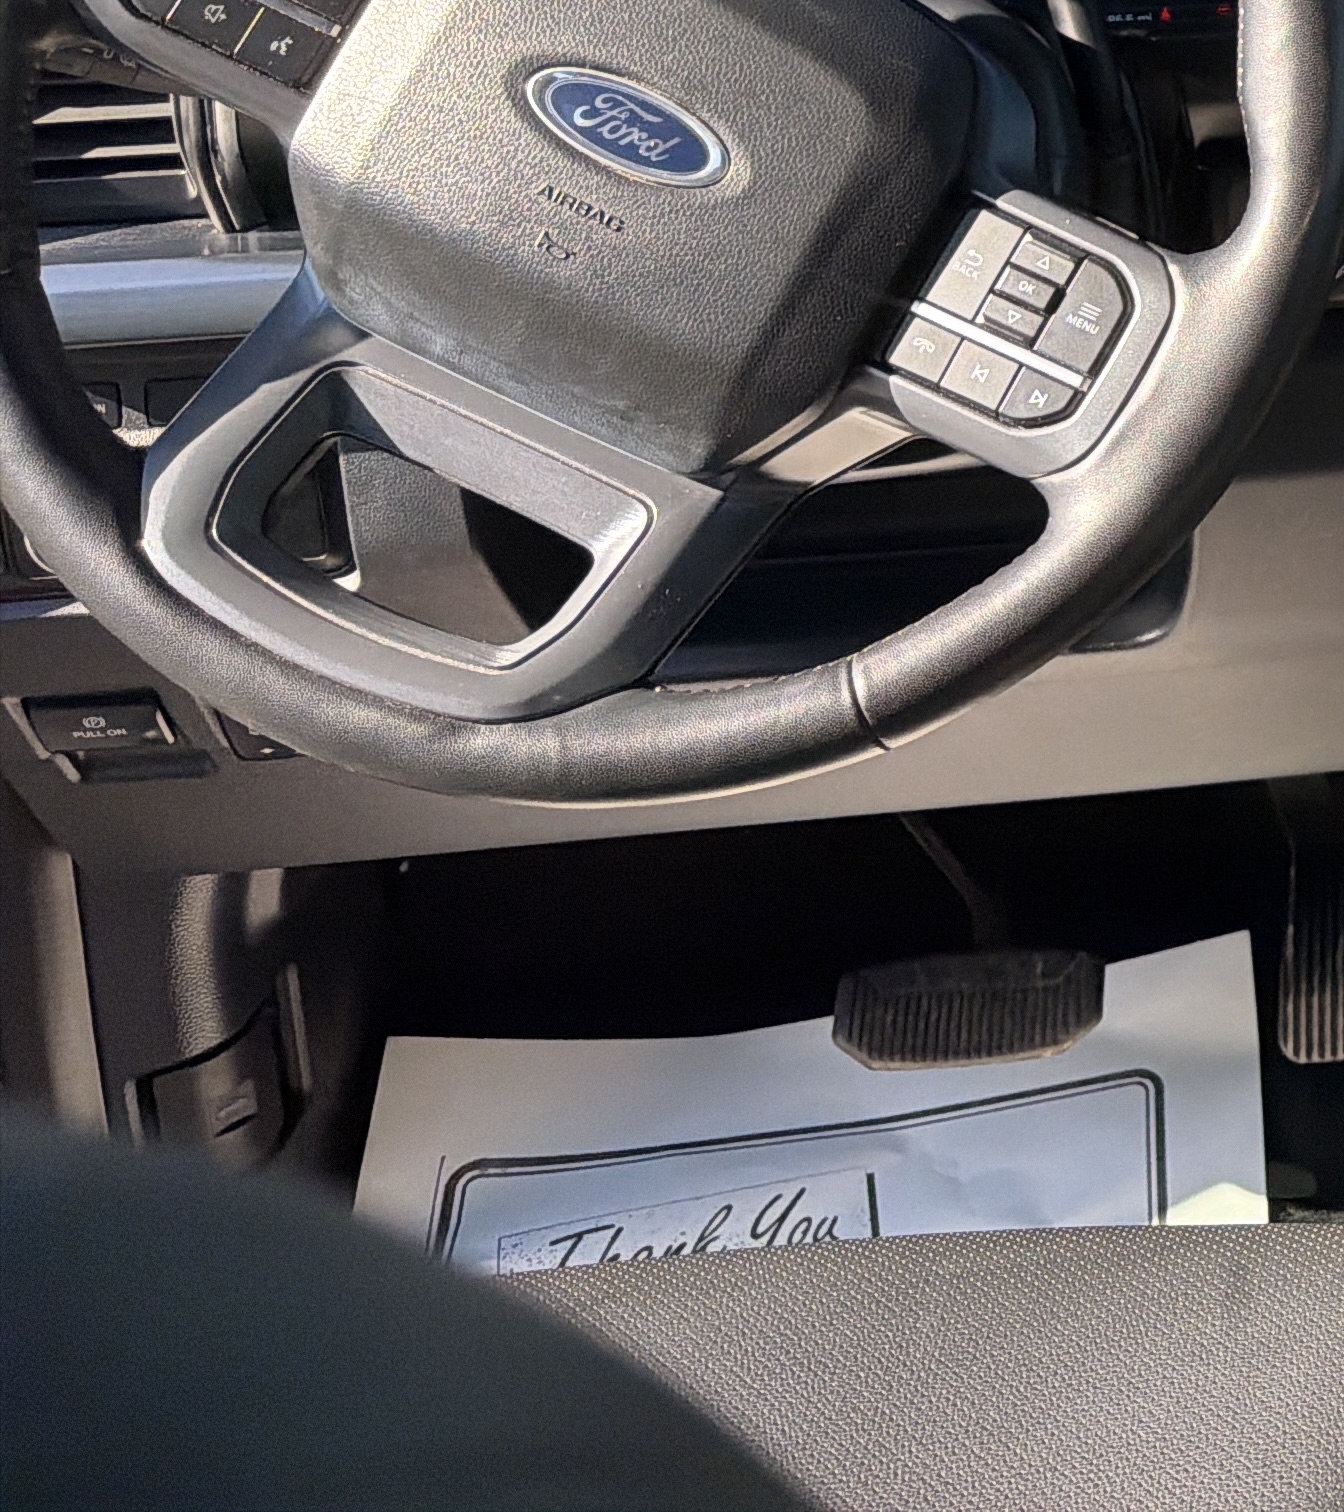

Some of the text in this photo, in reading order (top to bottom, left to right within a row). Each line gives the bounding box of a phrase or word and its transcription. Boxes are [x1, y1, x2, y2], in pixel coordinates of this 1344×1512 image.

[573, 92, 682, 162] Ford
[537, 185, 626, 233] AIRBAG
[952, 260, 982, 280] BACK
[1018, 280, 1036, 296] OK
[1066, 313, 1100, 335] MENU
[72, 728, 128, 739] PULL ON
[750, 1186, 841, 1247] You
